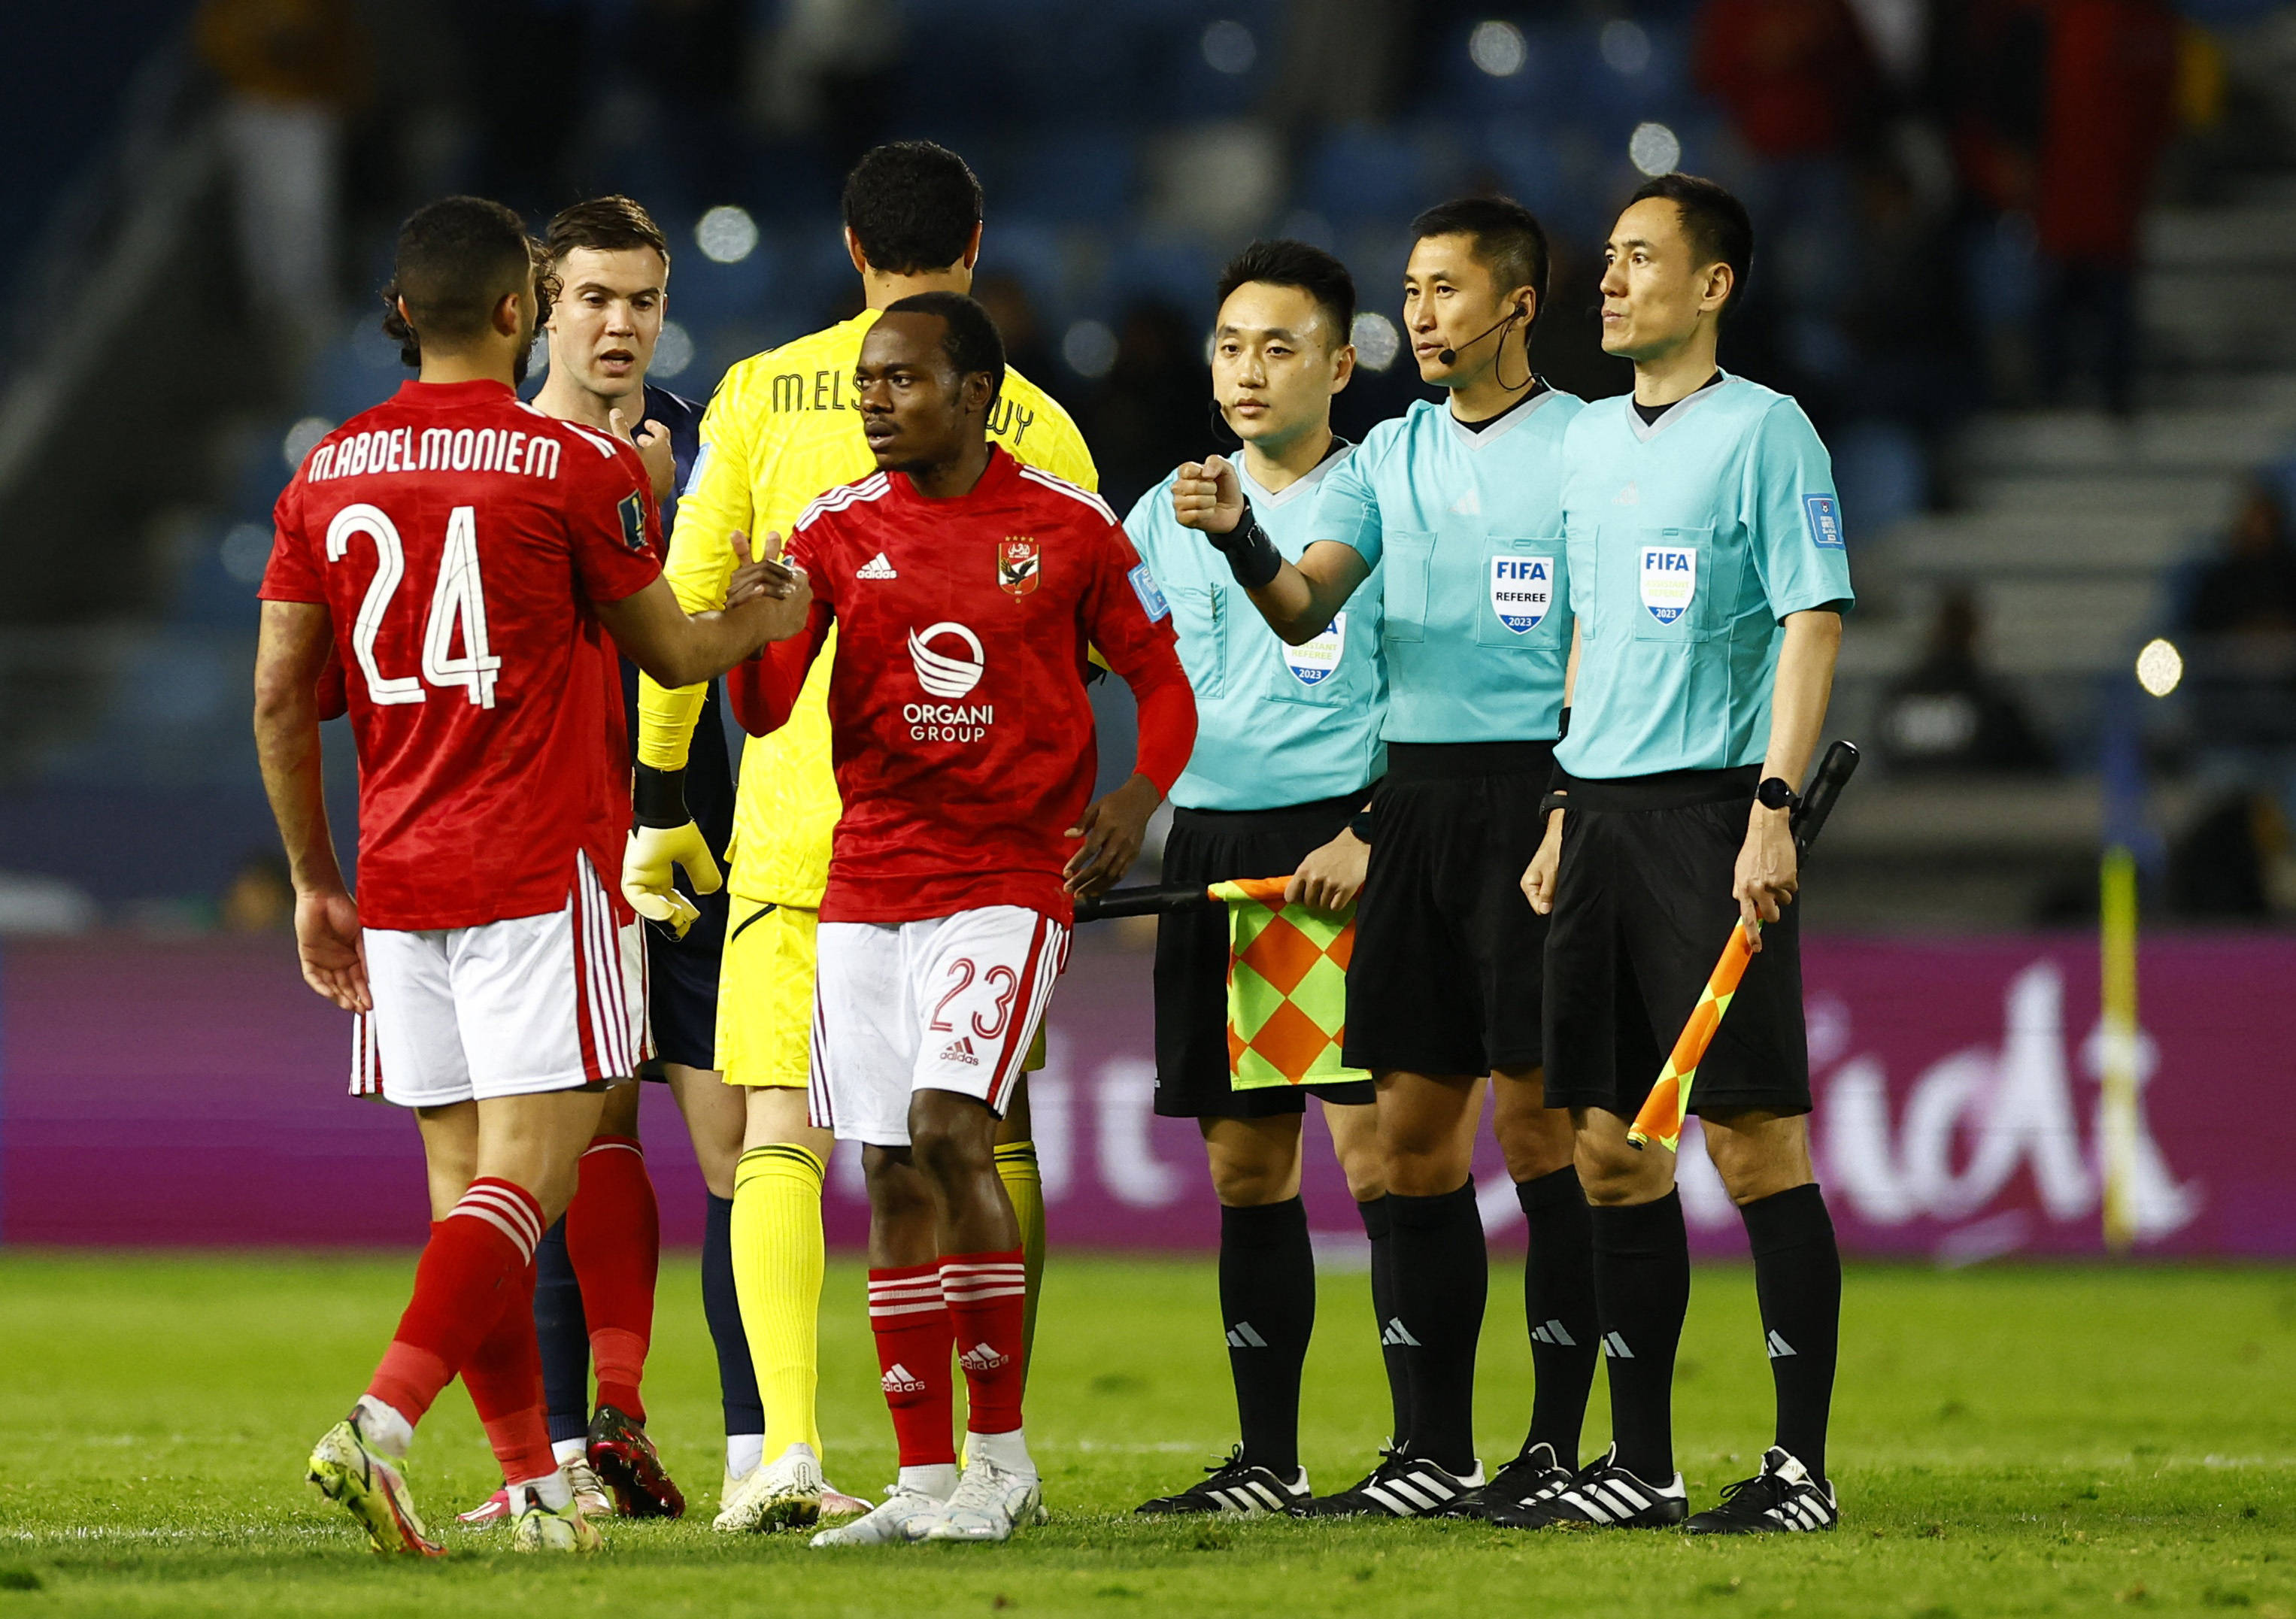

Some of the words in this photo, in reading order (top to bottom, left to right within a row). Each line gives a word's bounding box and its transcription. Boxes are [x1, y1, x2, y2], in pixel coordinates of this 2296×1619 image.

[308, 425, 562, 484] M.ABDELMONIEM
[1645, 552, 1690, 572] FIFA
[856, 569, 896, 579] adidas
[1497, 561, 1547, 581] FIFA
[1496, 591, 1546, 602] REFEREE
[326, 503, 502, 709] 24
[1655, 608, 1677, 618] 2023
[1508, 617, 1532, 626] 2023
[1291, 649, 1333, 660] REFEREE
[1298, 669, 1322, 680] 2023
[903, 703, 993, 725] ORGANI
[910, 726, 985, 742] GROUP
[929, 957, 1018, 1040] 23
[939, 1051, 980, 1066] adidas
